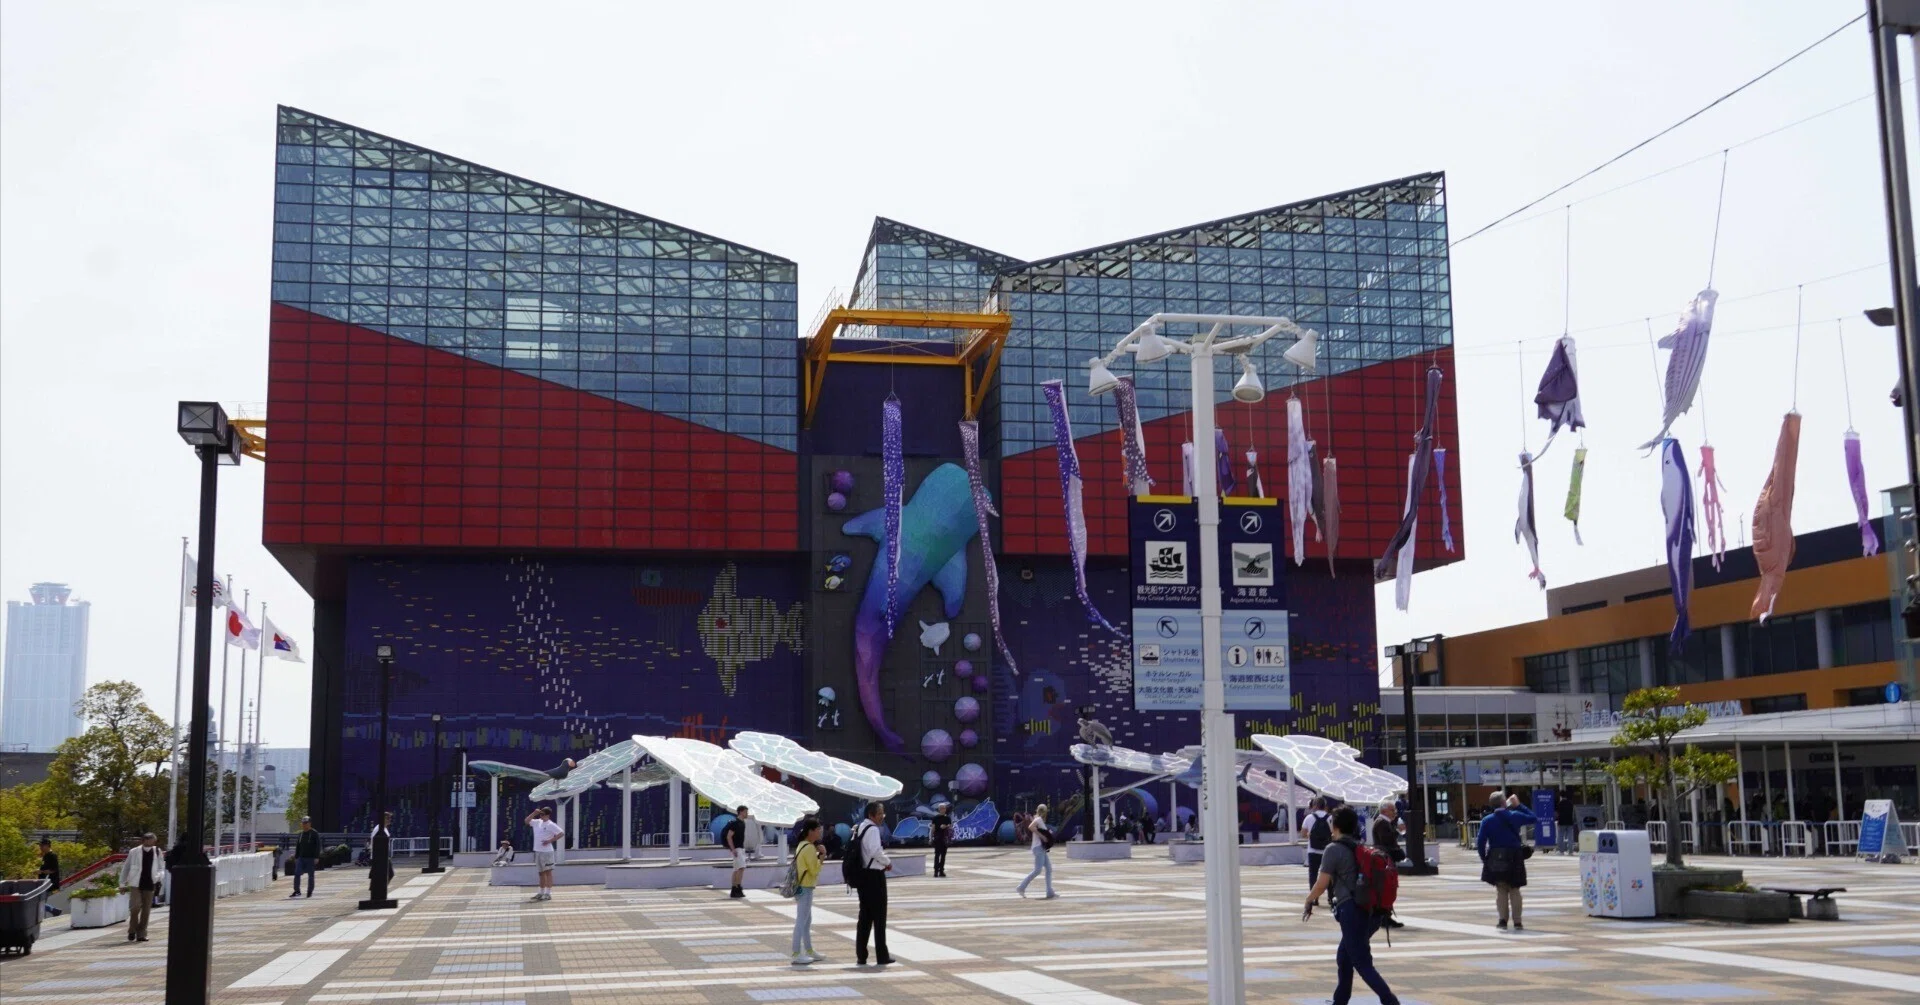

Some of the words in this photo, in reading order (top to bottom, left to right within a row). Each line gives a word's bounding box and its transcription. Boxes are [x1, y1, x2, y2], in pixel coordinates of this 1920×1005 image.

[1136, 585, 1196, 595] 観光船サンタマリア
[1237, 587, 1268, 597] 海遊館
[1163, 648, 1199, 656] シャトル船
[1229, 674, 1285, 683] 海遊館西はとば
